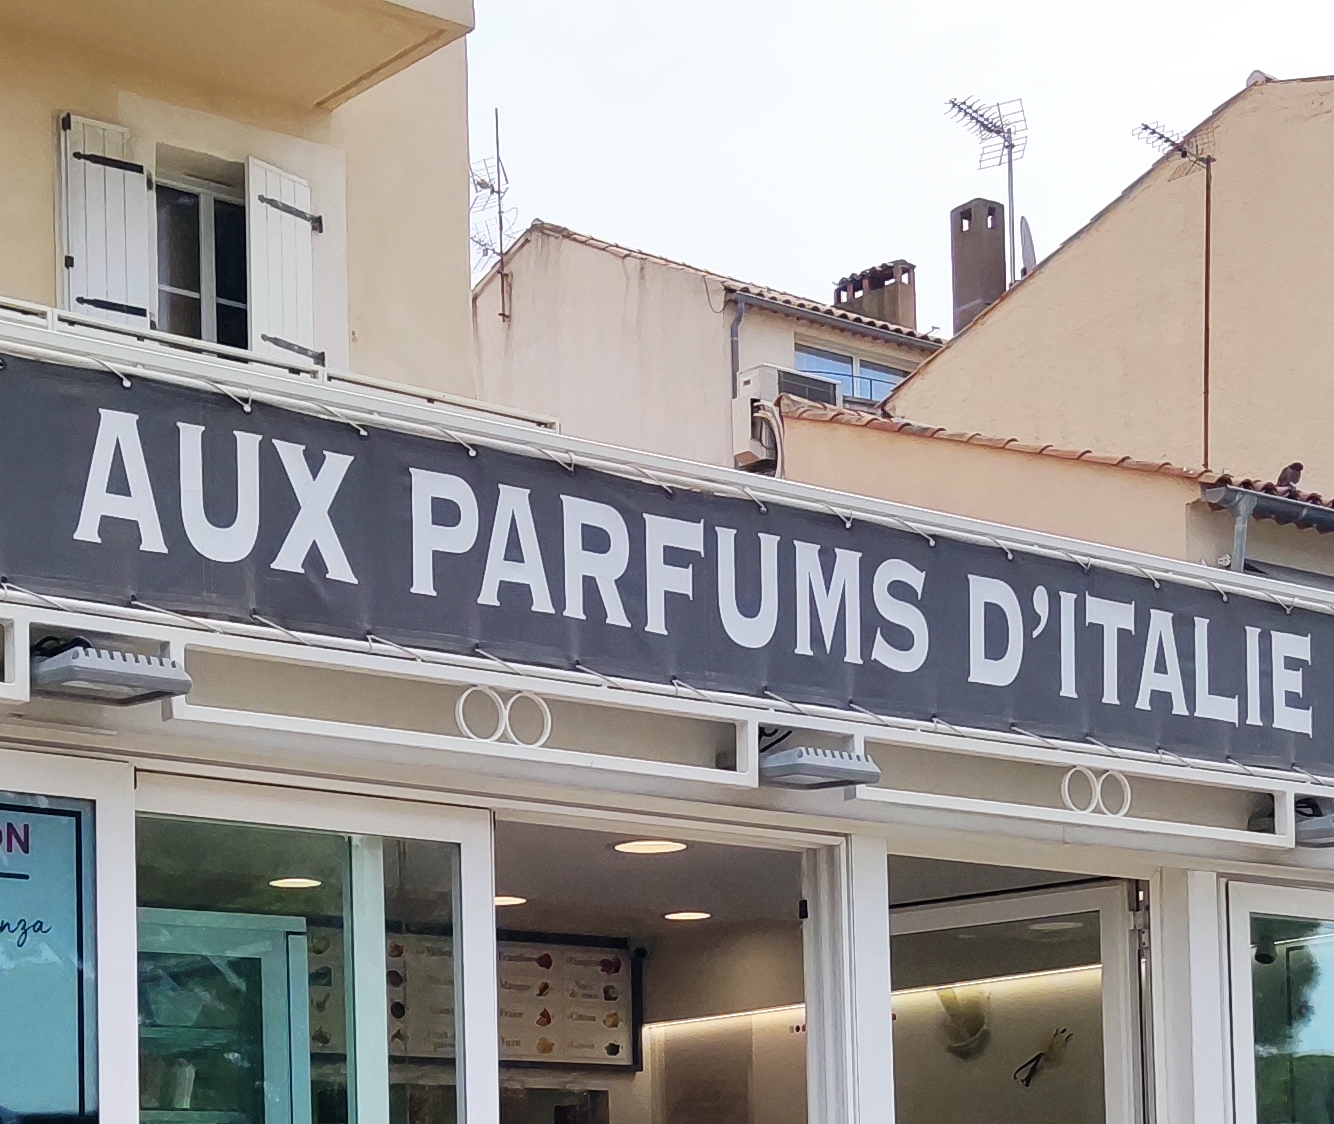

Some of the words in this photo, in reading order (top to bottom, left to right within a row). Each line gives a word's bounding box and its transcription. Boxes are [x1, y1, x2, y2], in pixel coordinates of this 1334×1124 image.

[73, 408, 359, 585] AUX
[409, 467, 930, 675] PARFUMS
[965, 573, 1314, 739] D'ITALIE
